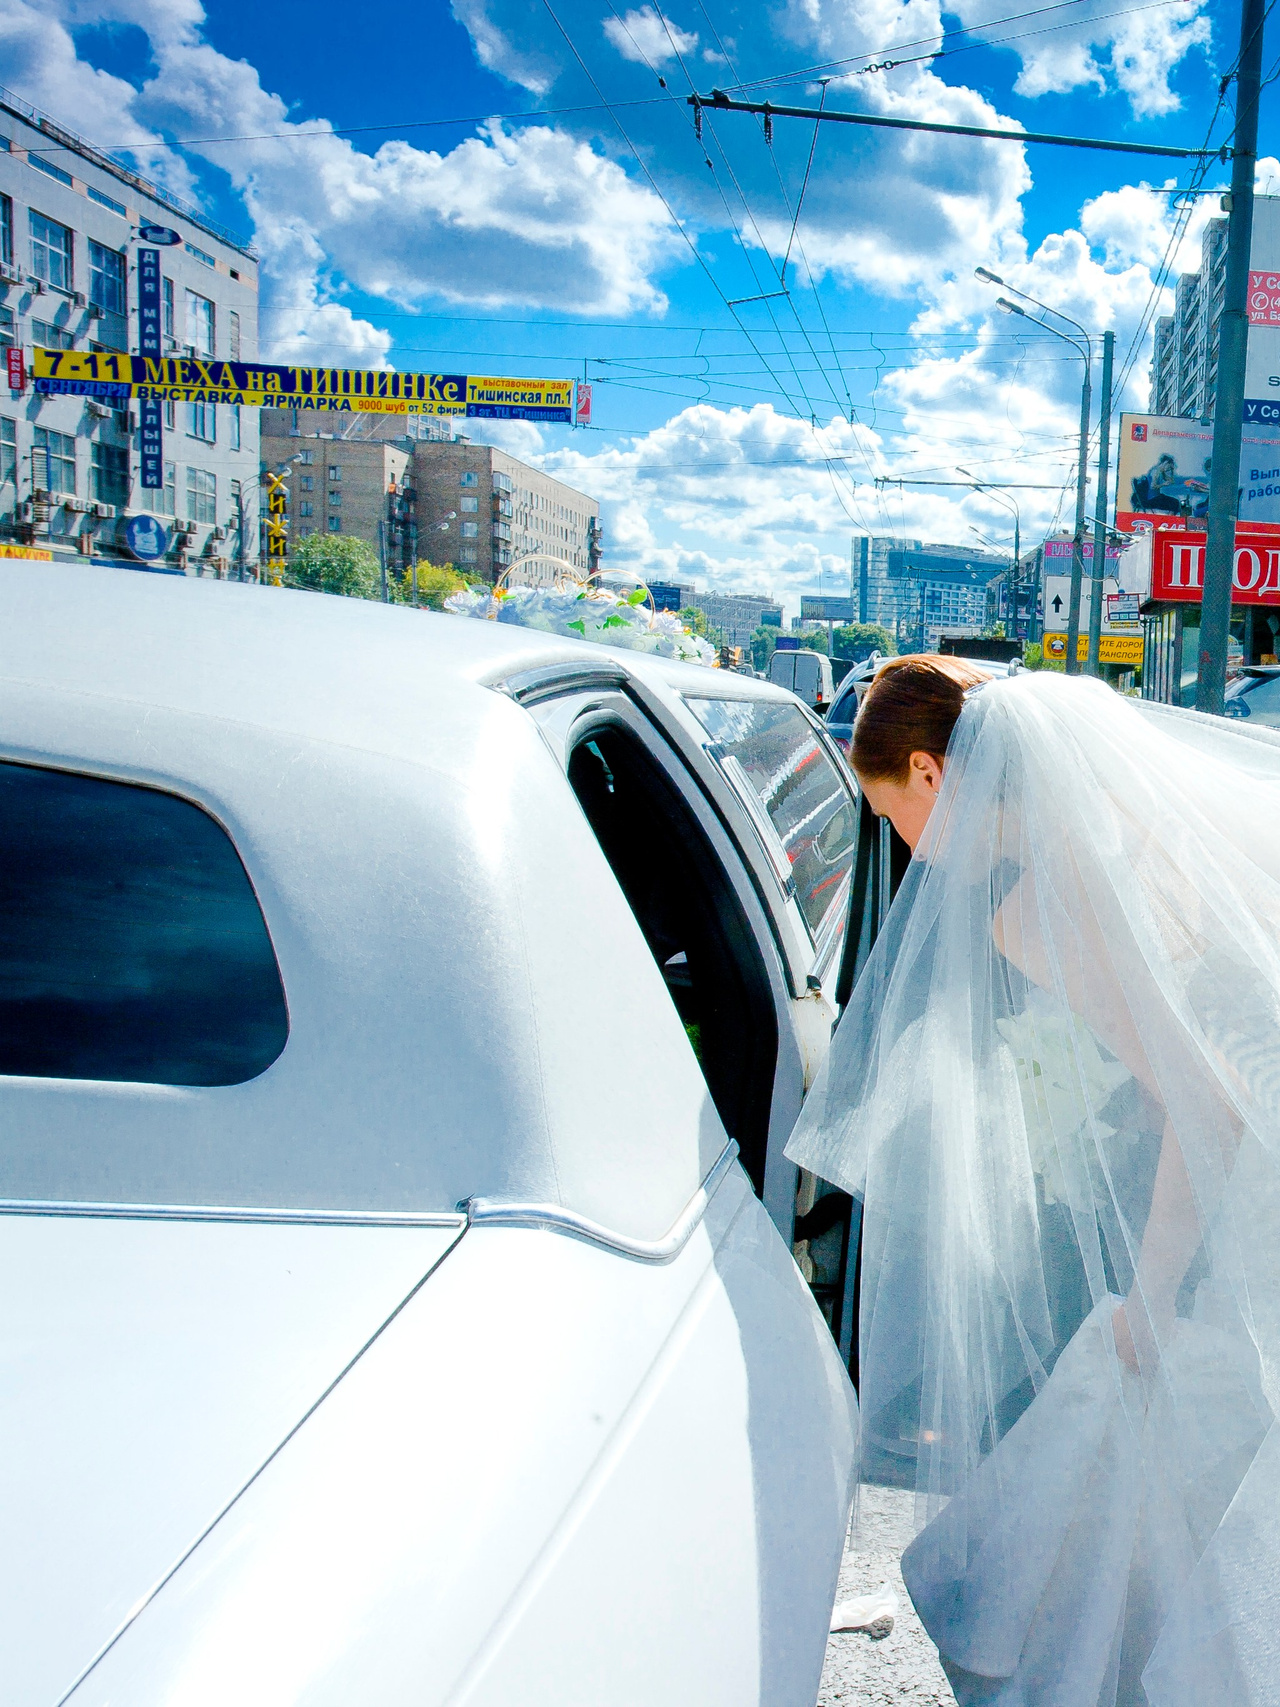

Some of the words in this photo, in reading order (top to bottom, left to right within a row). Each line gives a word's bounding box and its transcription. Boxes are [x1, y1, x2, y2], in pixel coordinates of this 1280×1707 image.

[142, 250, 156, 293] ДЛЯ
[1252, 275, 1264, 288] У
[1251, 311, 1267, 322] ул.
[143, 307, 158, 349] МАМ
[44, 351, 123, 380] 7-11
[141, 356, 240, 390] МЕХА
[245, 370, 283, 393] на
[35, 377, 130, 398] СЕНТЯБРЯ
[483, 378, 546, 390] выставочный
[550, 382, 568, 390] зал
[136, 385, 244, 406] ВЫСТАВКА
[262, 394, 352, 412] ЯРМАРКА
[358, 399, 383, 411] 9000
[385, 401, 406, 413] шуб
[408, 404, 420, 414] от
[422, 402, 435, 414] 52
[436, 404, 466, 416] фирм
[468, 384, 542, 404] Тишинская
[469, 405, 477, 417] 3
[478, 408, 493, 418] эт.
[494, 406, 511, 419] ТЦ
[1247, 404, 1257, 417] У
[144, 399, 160, 486] АЛЫШЕЙ
[1152, 428, 1197, 440] Департамент
[1115, 640, 1144, 649] ДОРОГ
